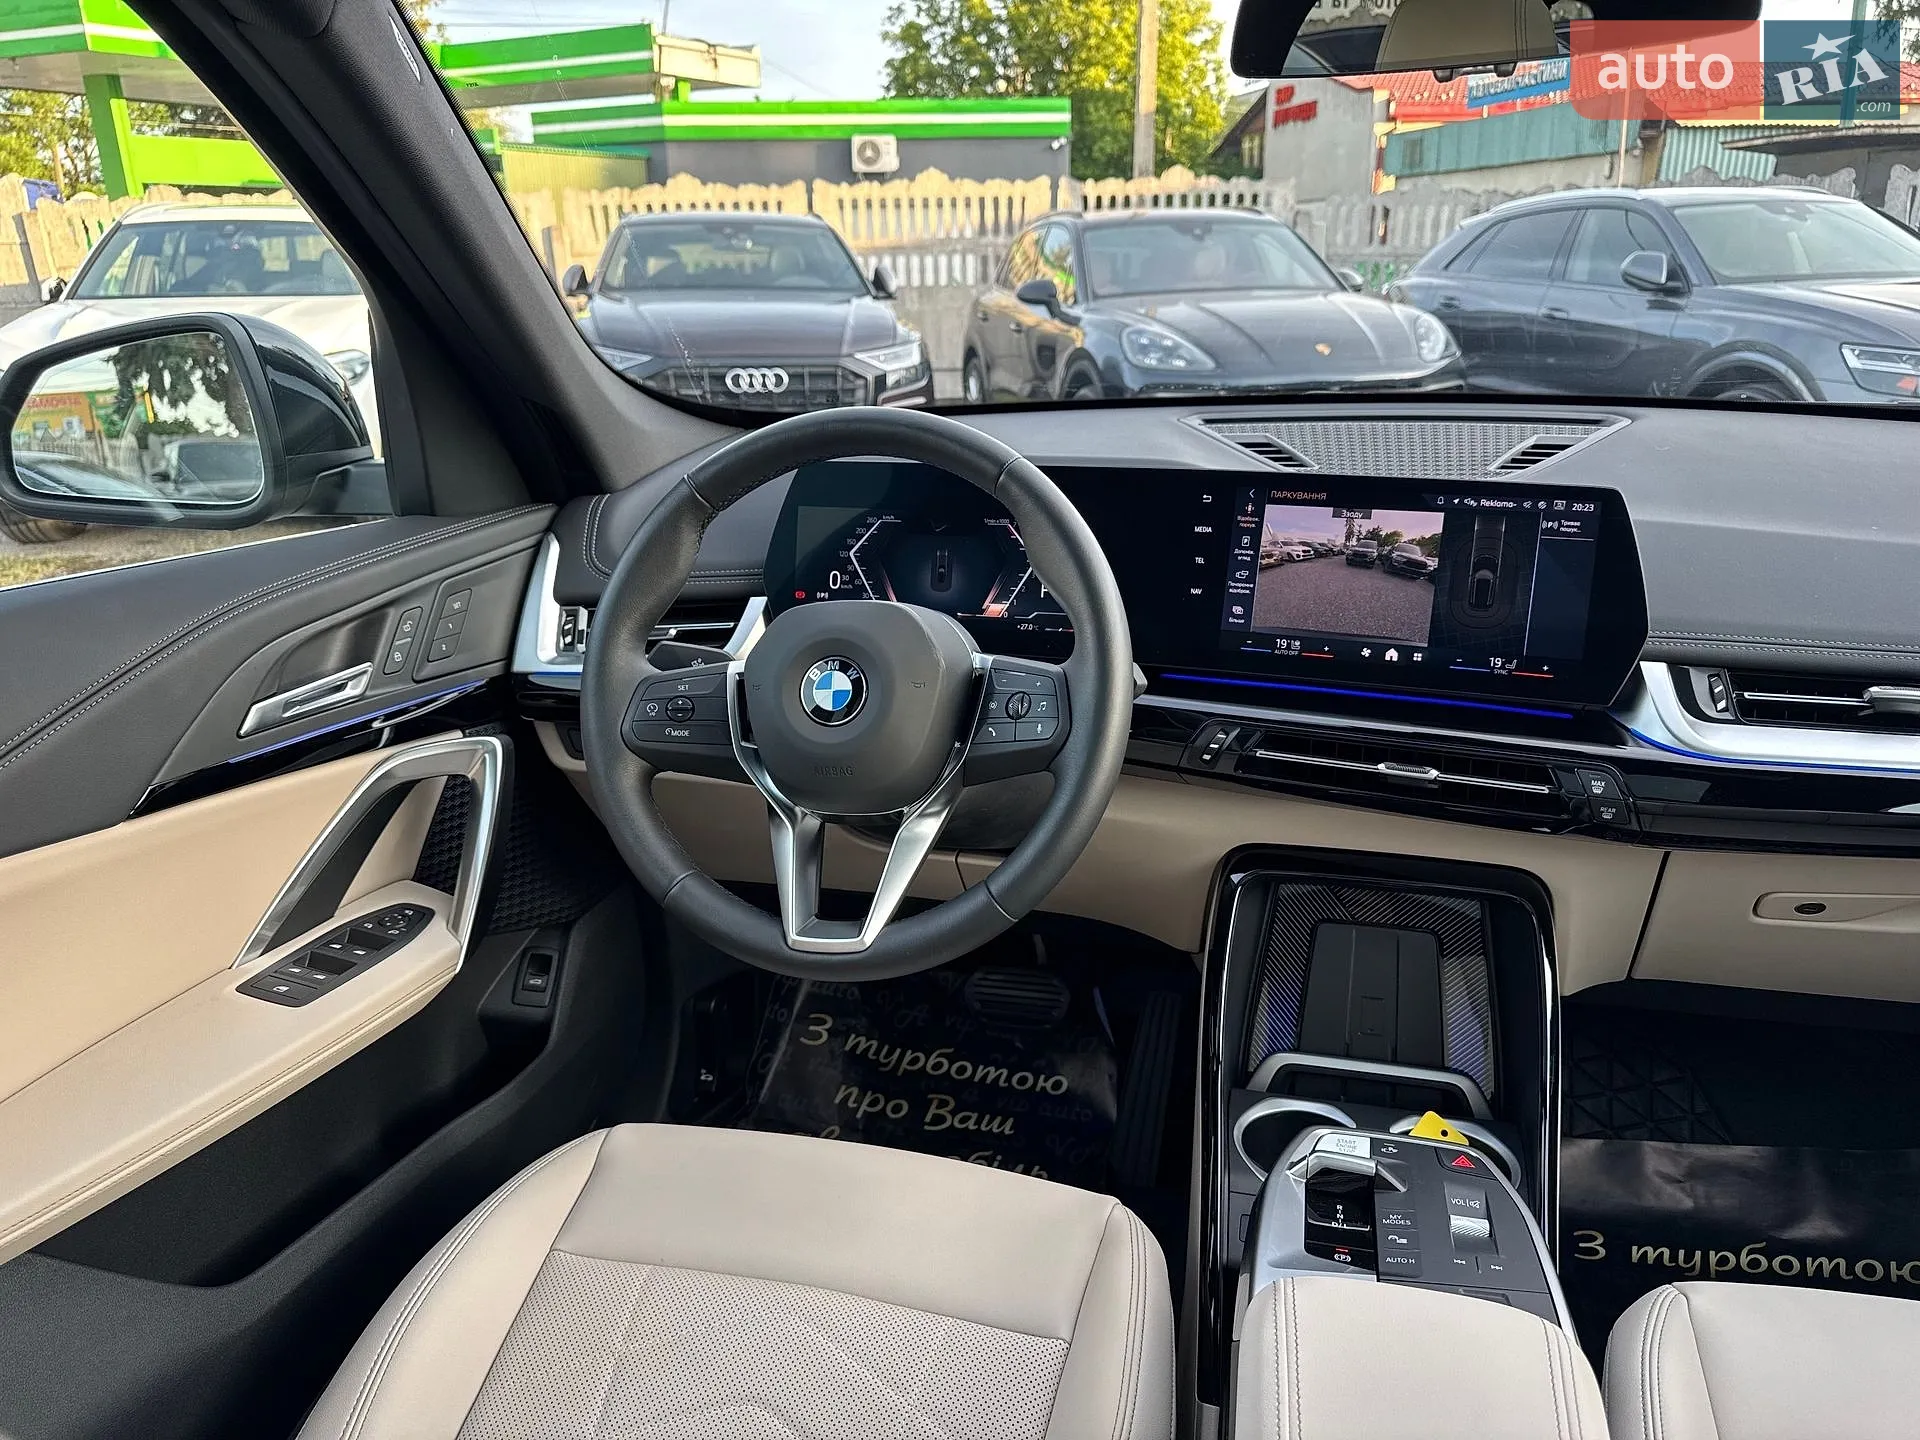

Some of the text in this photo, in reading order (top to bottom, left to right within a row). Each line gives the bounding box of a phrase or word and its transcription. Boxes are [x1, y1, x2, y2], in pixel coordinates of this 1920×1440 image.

[1271, 490, 1327, 500] ПАРКУВАННЯ
[1572, 503, 1595, 511] 20:23
[829, 570, 841, 590] 0
[808, 660, 860, 681] BMW
[672, 729, 691, 737] MODE
[814, 765, 854, 777] AIRBAG
[1600, 806, 1617, 814] REAR
[799, 1013, 834, 1046] З
[844, 1030, 1069, 1097] турботою
[833, 1082, 1015, 1136] про Ваш
[1450, 1198, 1466, 1206] VOL
[1573, 1230, 1920, 1285] З турботою
